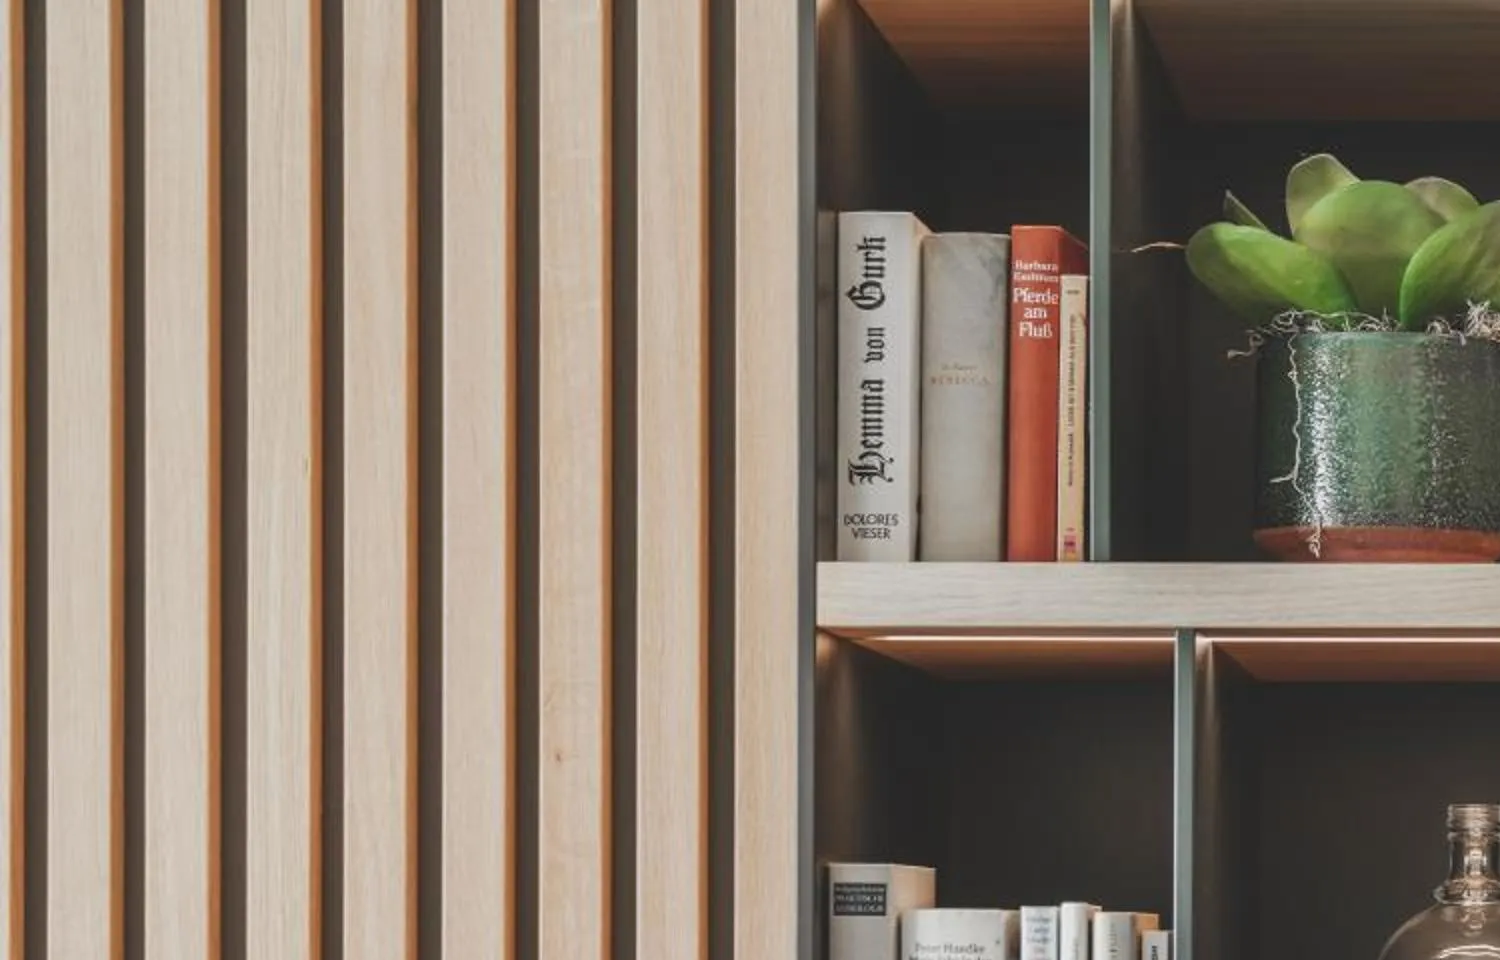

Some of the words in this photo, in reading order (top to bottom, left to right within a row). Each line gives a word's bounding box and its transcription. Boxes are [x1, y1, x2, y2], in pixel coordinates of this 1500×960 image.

[845, 236, 886, 310] Gurk
[1013, 287, 1059, 305] Pferde
[1023, 307, 1048, 319] am
[1018, 321, 1054, 338] Fluß
[863, 327, 885, 363] von
[847, 379, 894, 486] Hemma
[843, 513, 899, 526] DOLORES
[851, 527, 891, 540] VIESER
